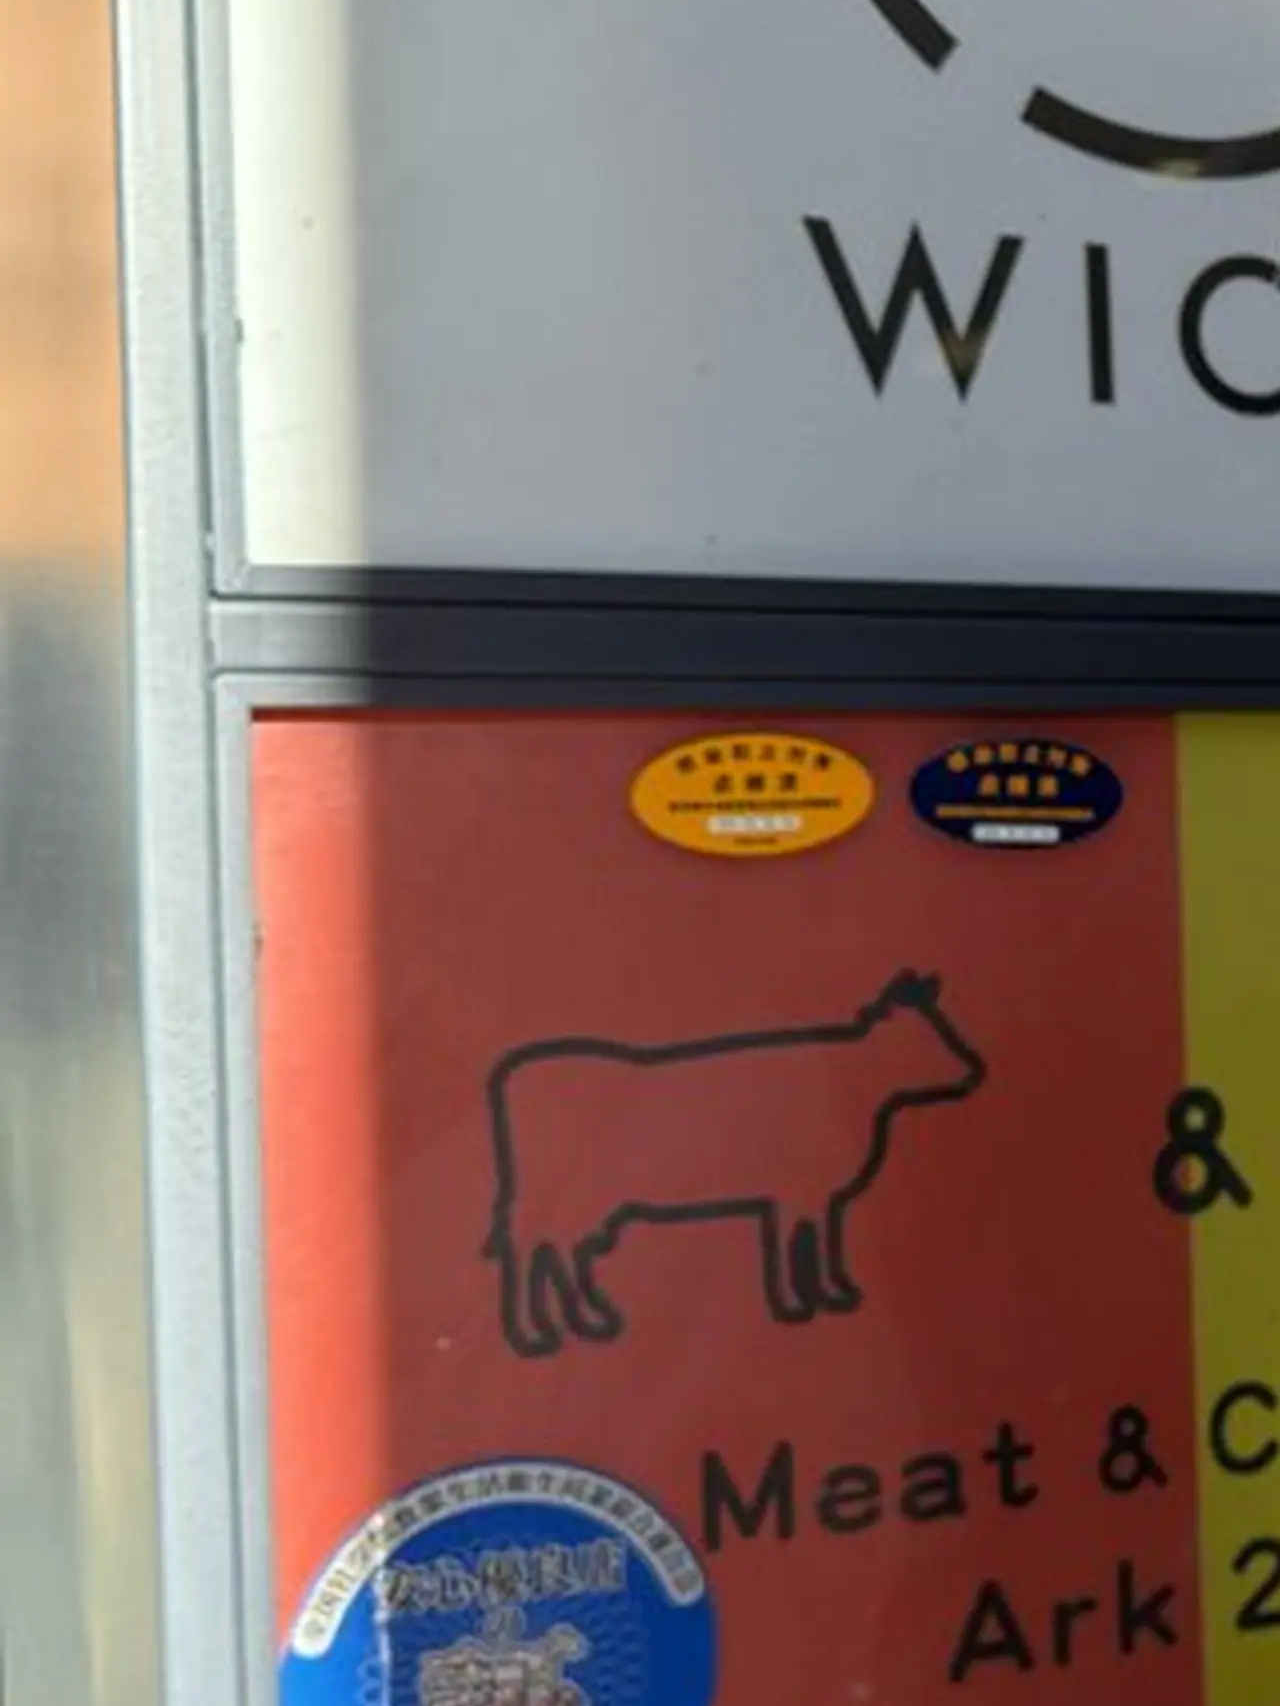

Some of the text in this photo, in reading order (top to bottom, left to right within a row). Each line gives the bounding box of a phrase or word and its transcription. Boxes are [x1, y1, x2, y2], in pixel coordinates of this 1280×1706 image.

[1153, 1086, 1255, 1215] &
[701, 1420, 1040, 1555] Meat
[1098, 1405, 1169, 1493] &
[947, 1560, 1178, 1684] Ark
